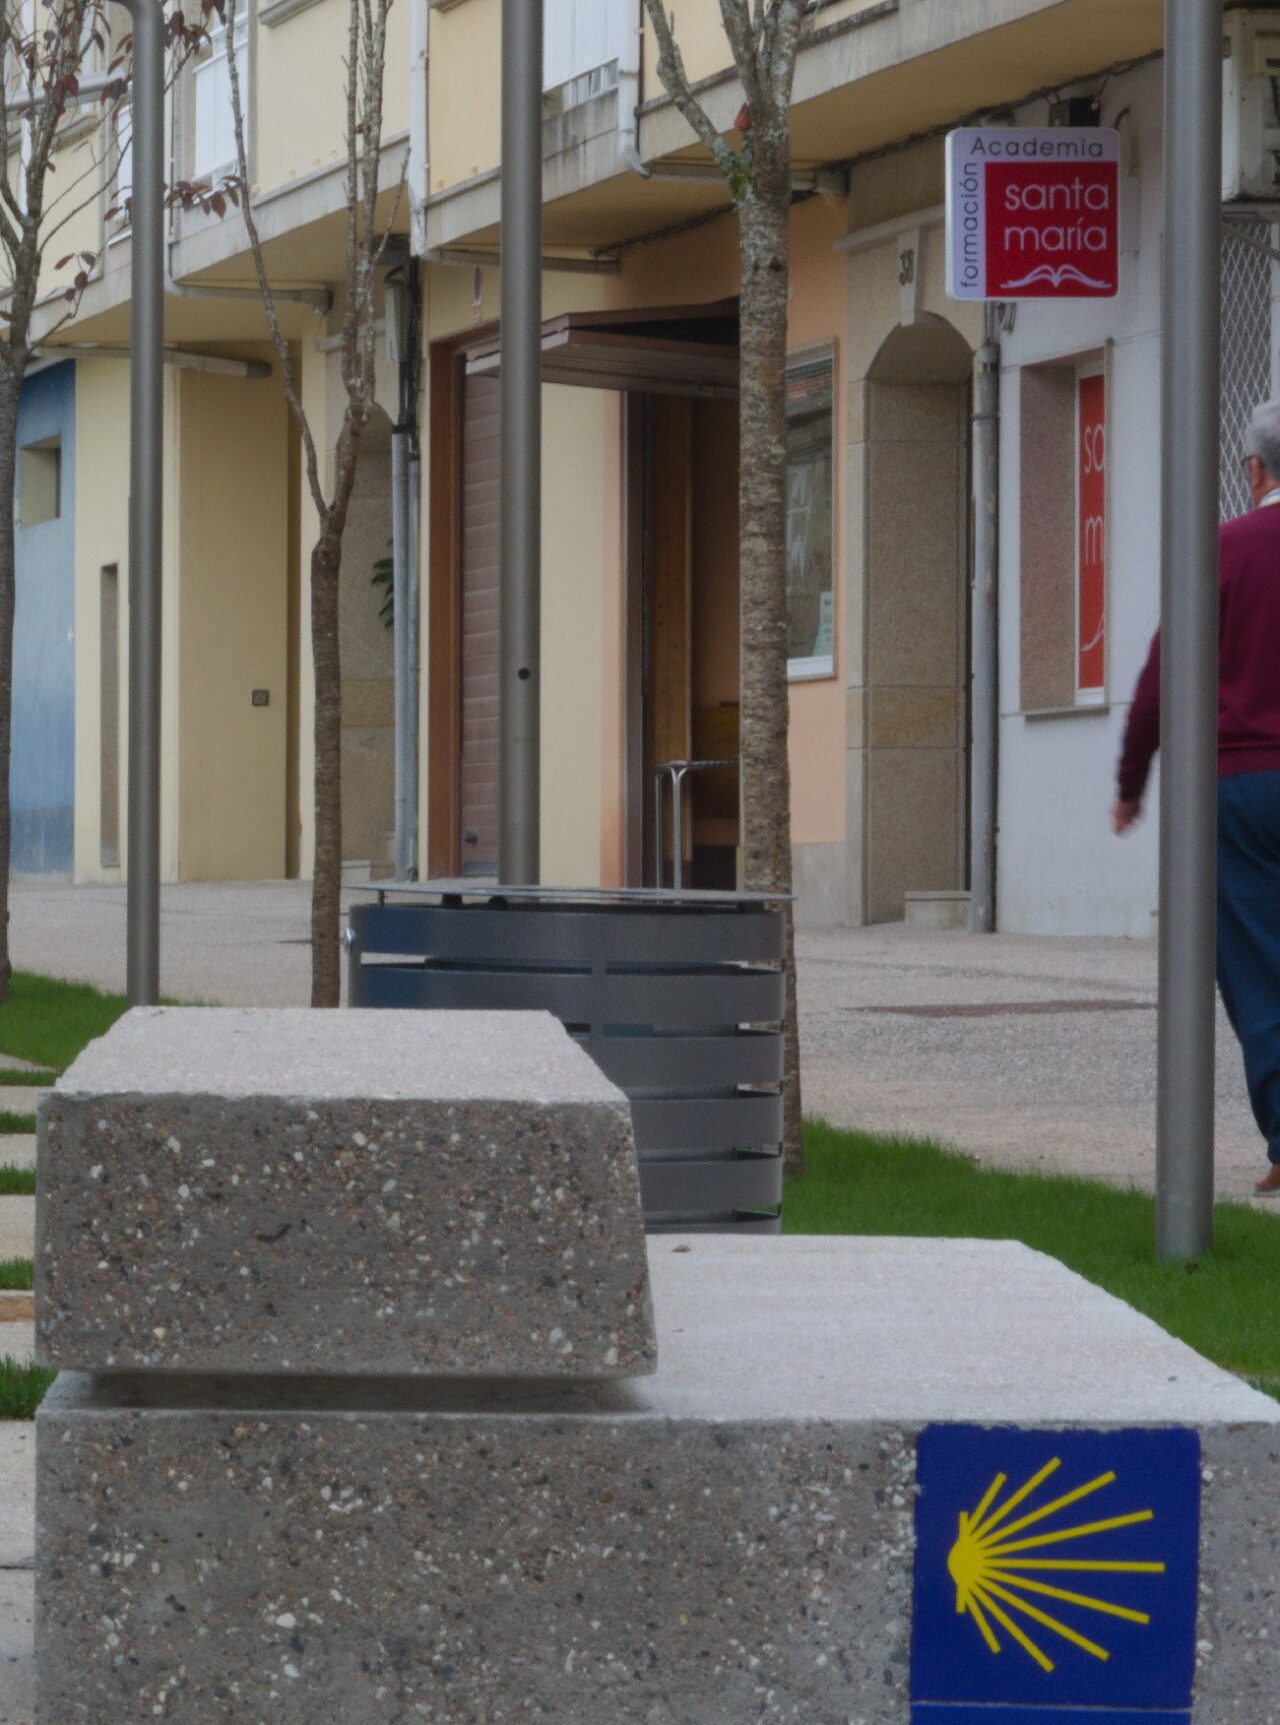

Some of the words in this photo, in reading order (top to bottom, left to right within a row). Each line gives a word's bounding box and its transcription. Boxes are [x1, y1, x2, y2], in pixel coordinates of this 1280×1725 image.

[970, 137, 1104, 157] Academia
[1004, 177, 1110, 211] santa
[959, 162, 979, 288] formación
[1004, 217, 1108, 252] maría
